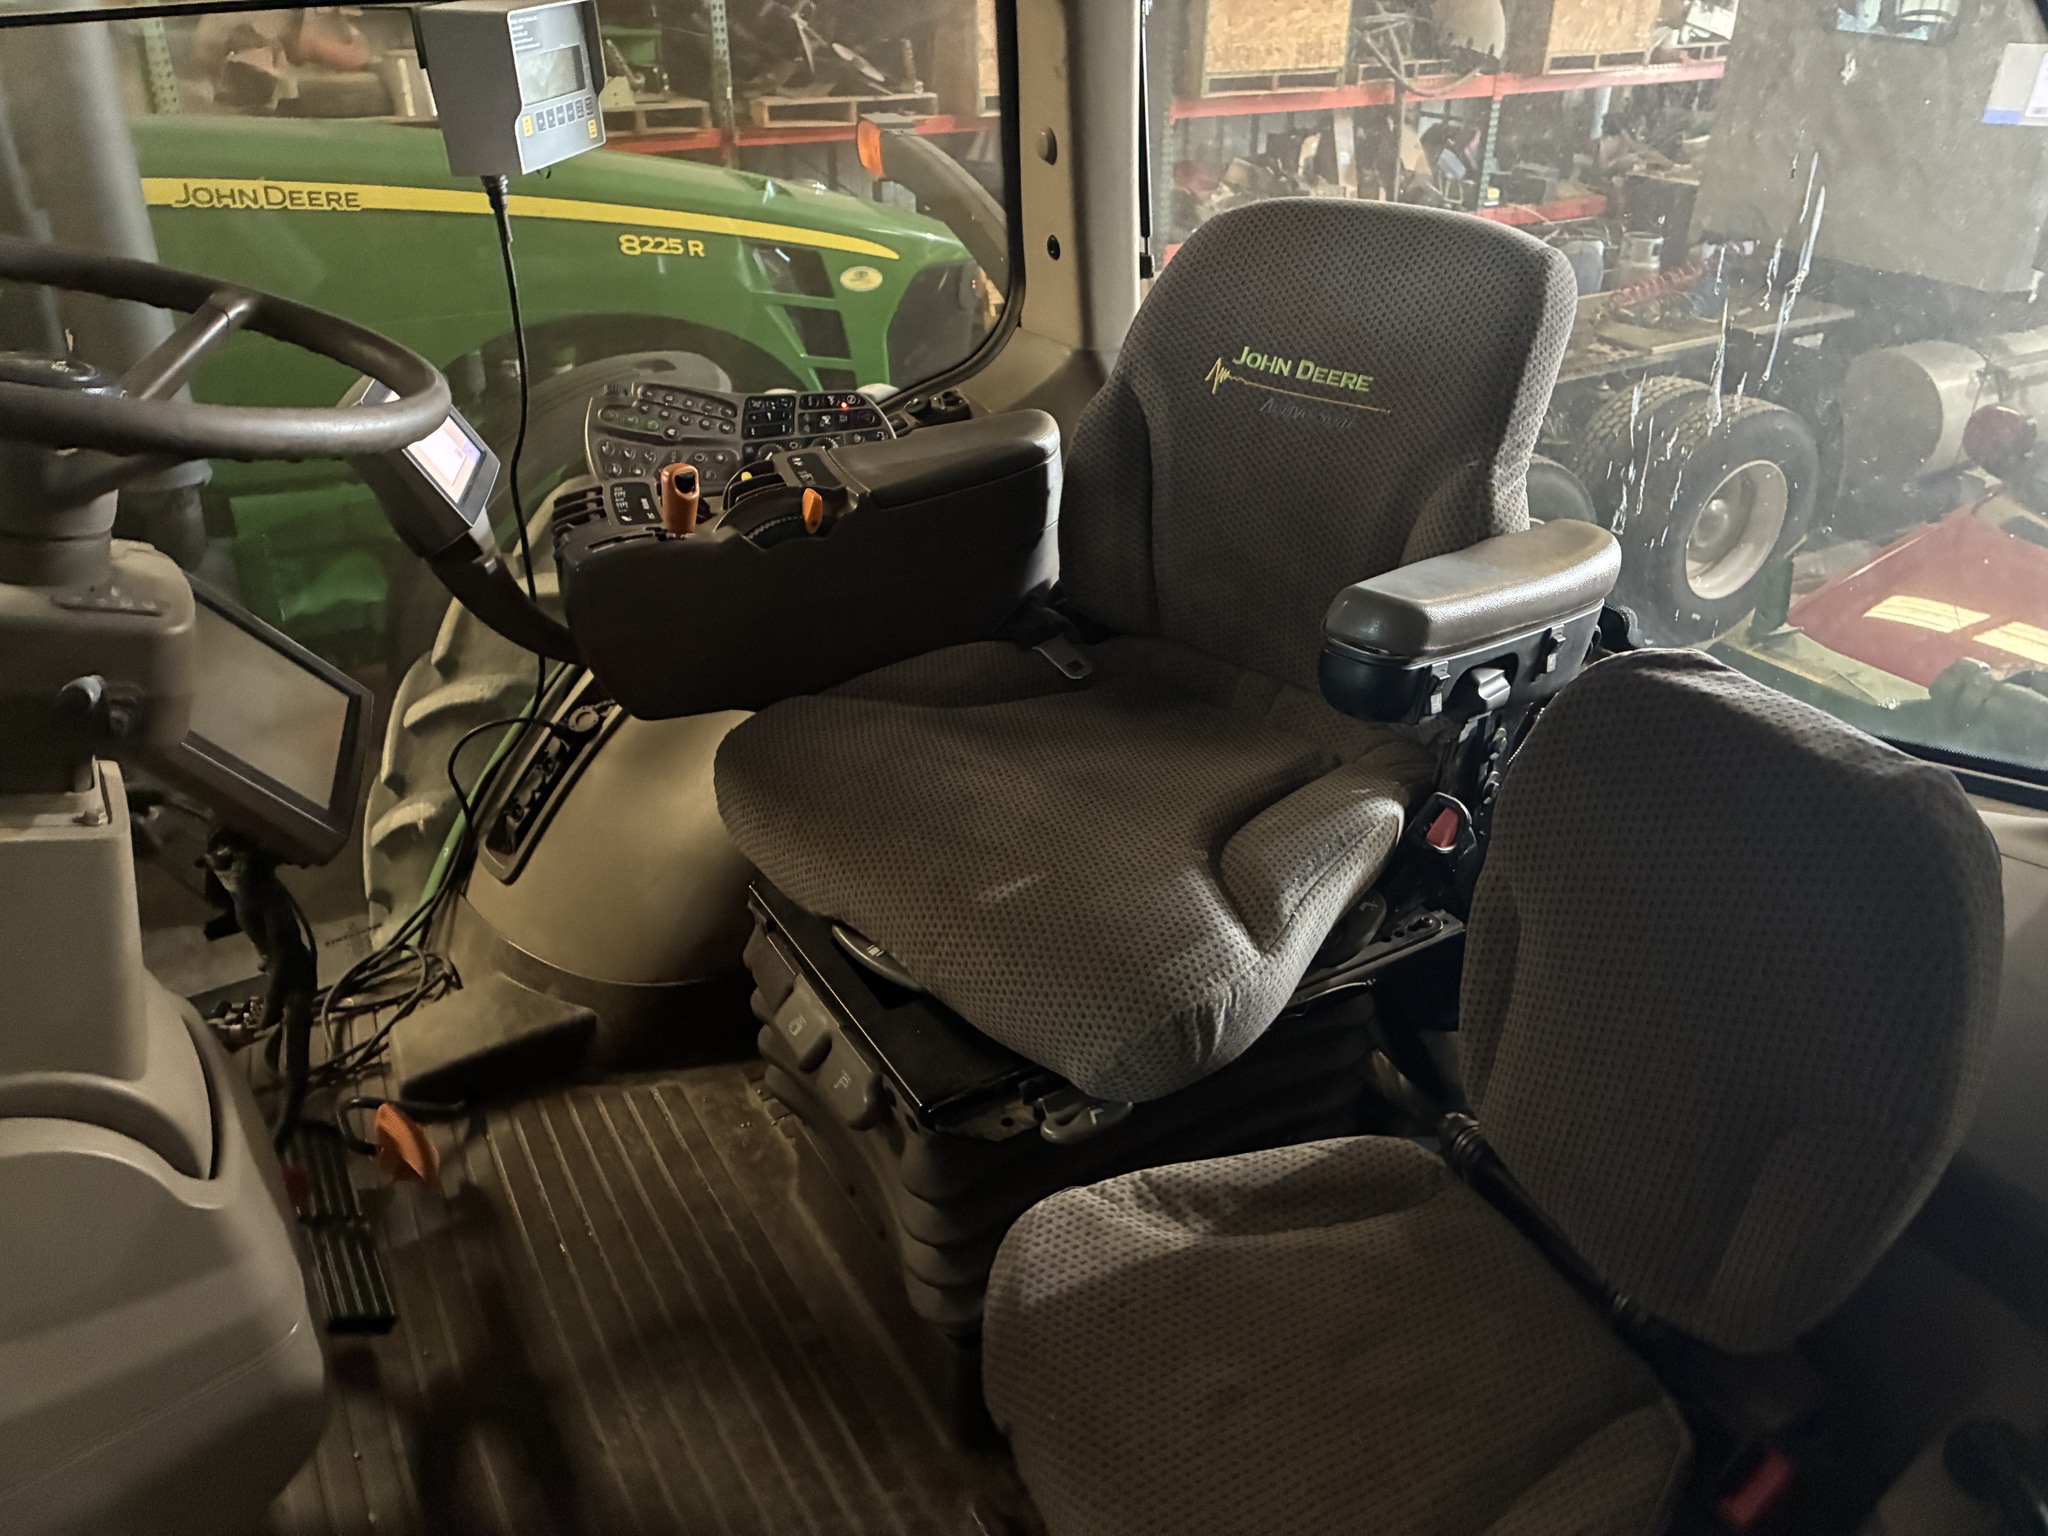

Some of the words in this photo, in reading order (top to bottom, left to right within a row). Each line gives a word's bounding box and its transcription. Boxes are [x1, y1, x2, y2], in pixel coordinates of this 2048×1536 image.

[174, 183, 259, 206] JOHN
[263, 185, 362, 209] DEERE
[618, 233, 685, 256] 8225
[687, 239, 706, 257] R
[1232, 346, 1293, 377] JOHN
[1295, 358, 1374, 392] DEERE
